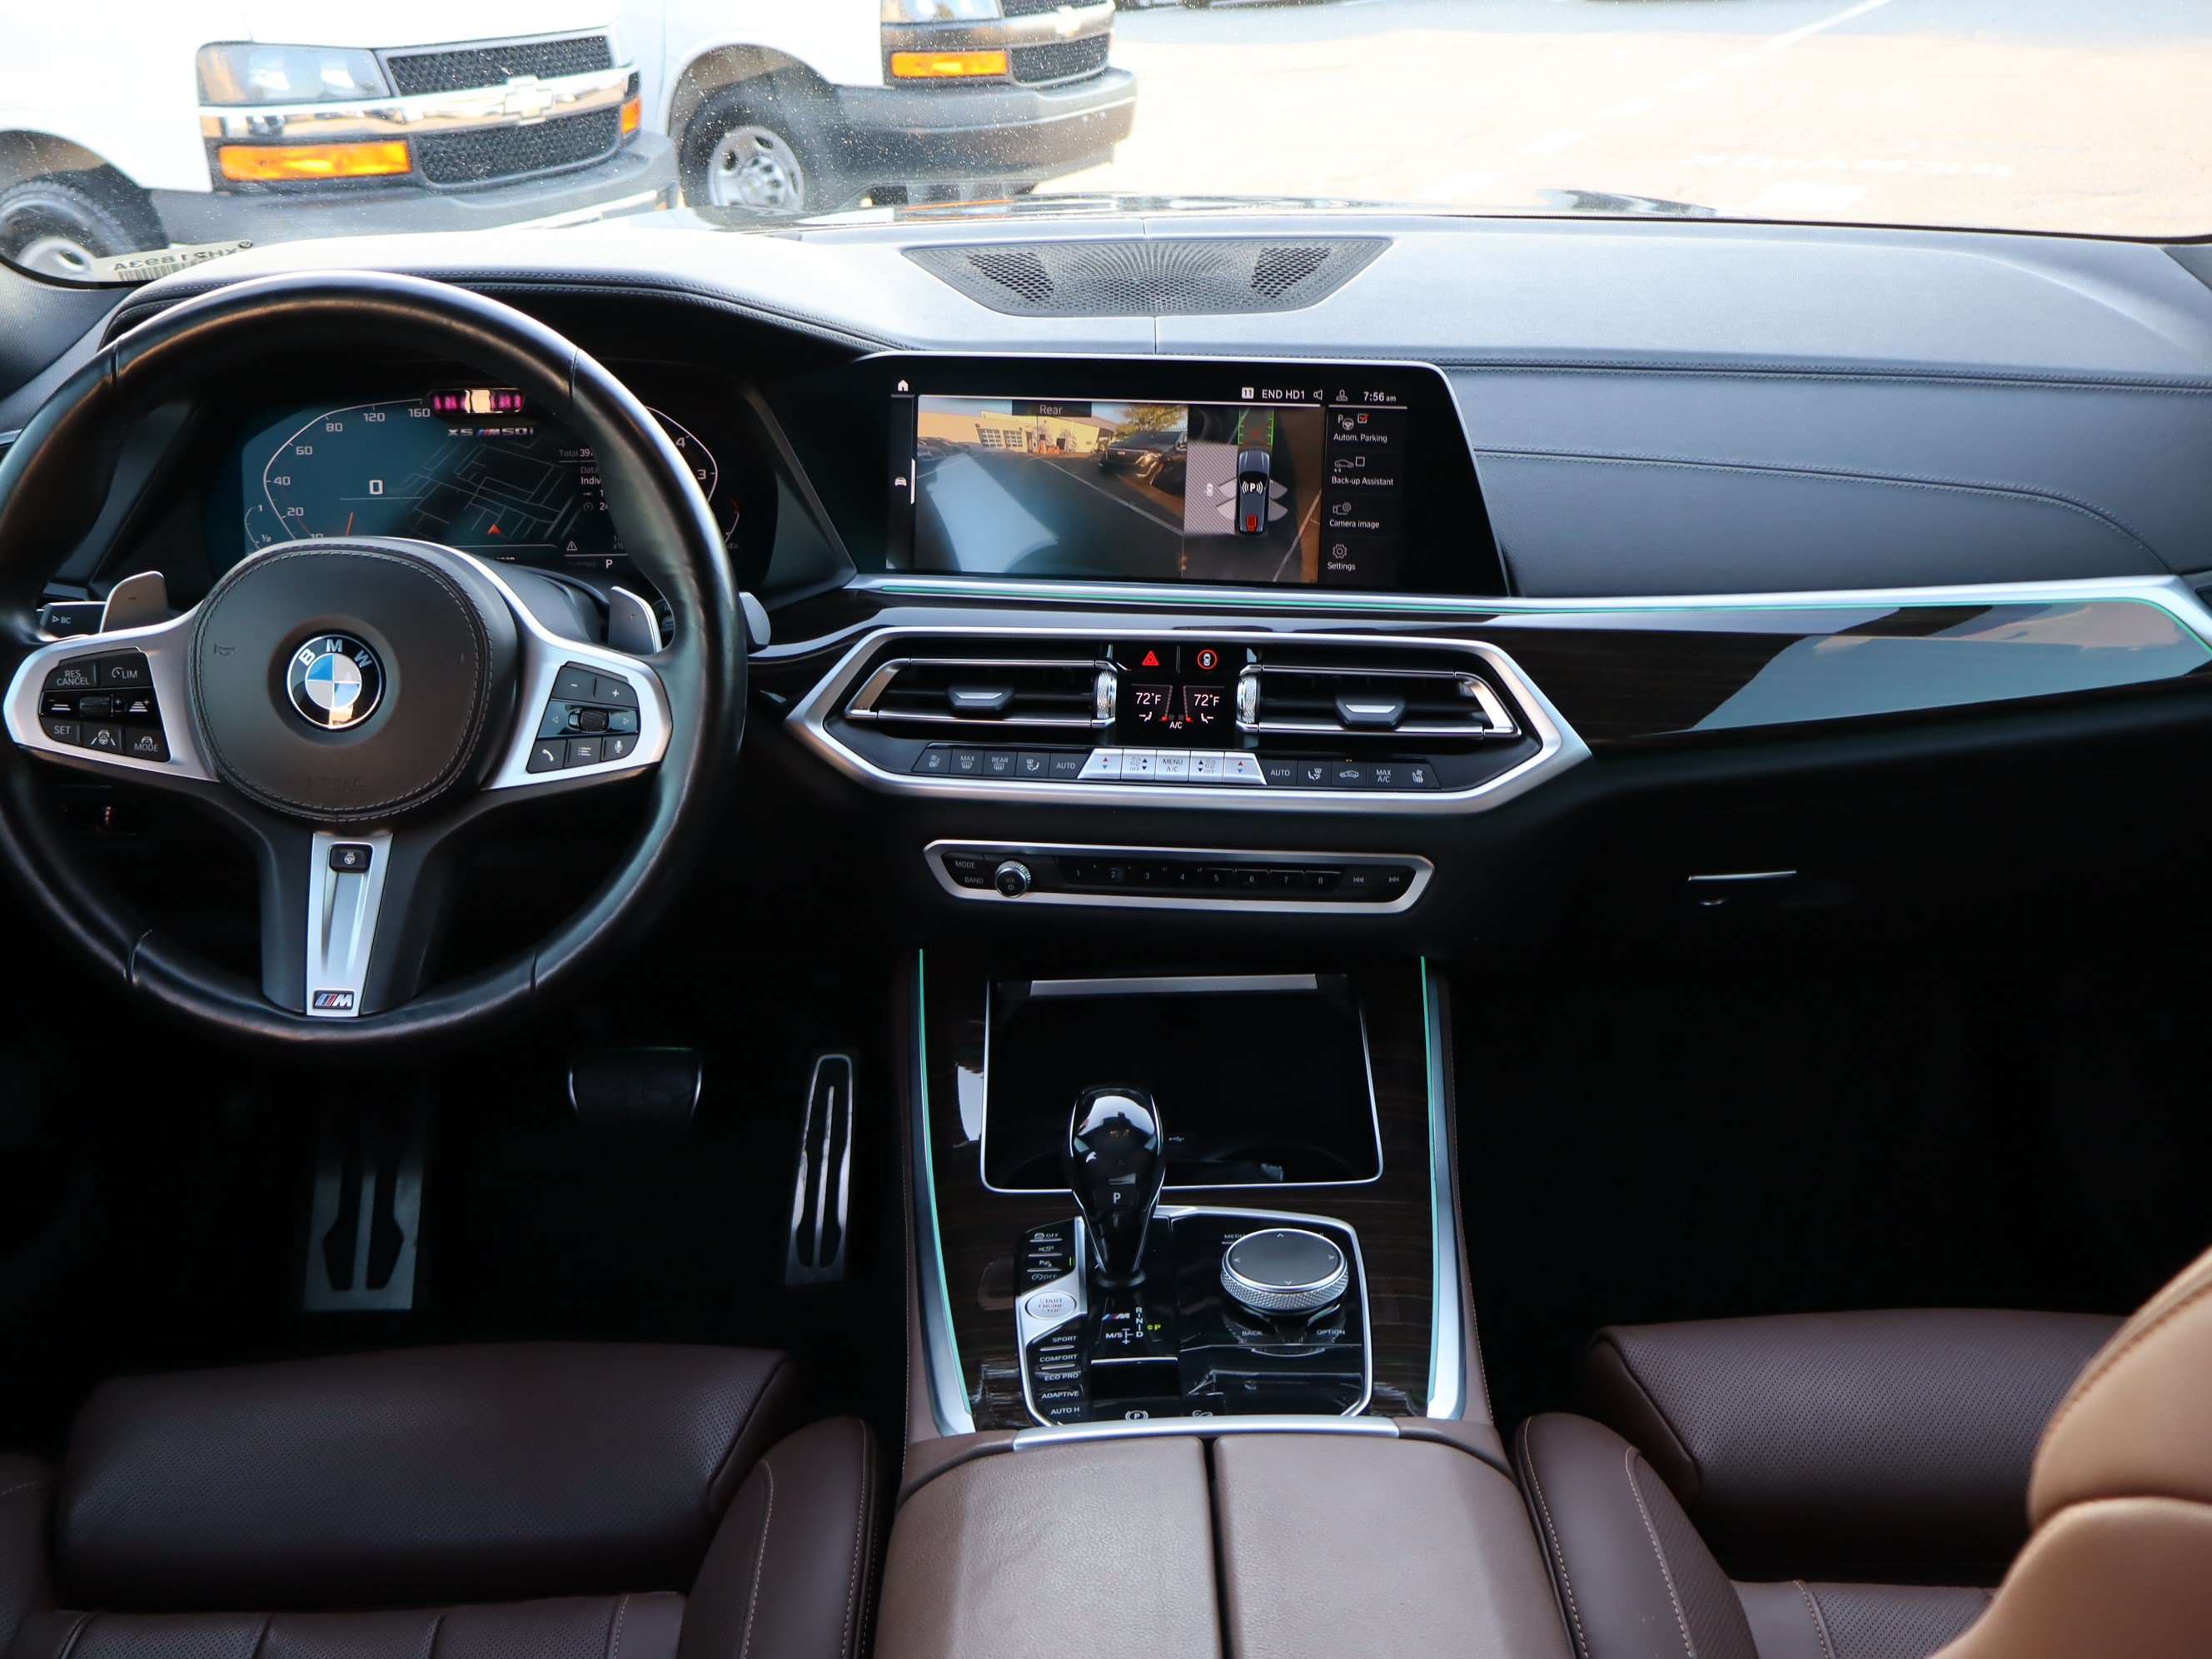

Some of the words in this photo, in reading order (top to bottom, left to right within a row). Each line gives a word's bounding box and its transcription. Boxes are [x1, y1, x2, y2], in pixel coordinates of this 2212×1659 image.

[1262, 389, 1283, 399] END
[1285, 390, 1305, 400] HD1
[1363, 391, 1384, 401] 7:56
[408, 408, 431, 417] 160
[1039, 405, 1062, 415] Rear
[363, 412, 386, 422] 120
[326, 422, 343, 432] 80
[447, 428, 474, 436] X5
[675, 437, 685, 448] 4
[1333, 433, 1358, 442] Autom.
[1360, 434, 1387, 443] Parking
[296, 446, 313, 456] 60
[697, 469, 707, 480] 3
[273, 476, 291, 486] 40
[1332, 476, 1360, 486] Back-up
[1362, 477, 1394, 486] Assistant
[369, 480, 384, 495] 0
[287, 507, 304, 516] 20
[1329, 520, 1356, 528] Camera
[1358, 520, 1380, 530] image
[605, 559, 613, 568] P
[1328, 561, 1356, 571] Settings
[298, 639, 372, 668] BMW
[64, 670, 81, 678] RES
[122, 670, 138, 679] LIM
[57, 677, 90, 686] CANCEL
[54, 725, 71, 735] SET
[134, 742, 158, 752] MODE
[1056, 761, 1076, 770] AUTO
[955, 860, 976, 869] MODE
[964, 876, 984, 884] BAND
[1113, 1192, 1121, 1204] P
[1039, 1354, 1078, 1363] COMFORT
[1041, 1390, 1079, 1399] ADAPTIVE
